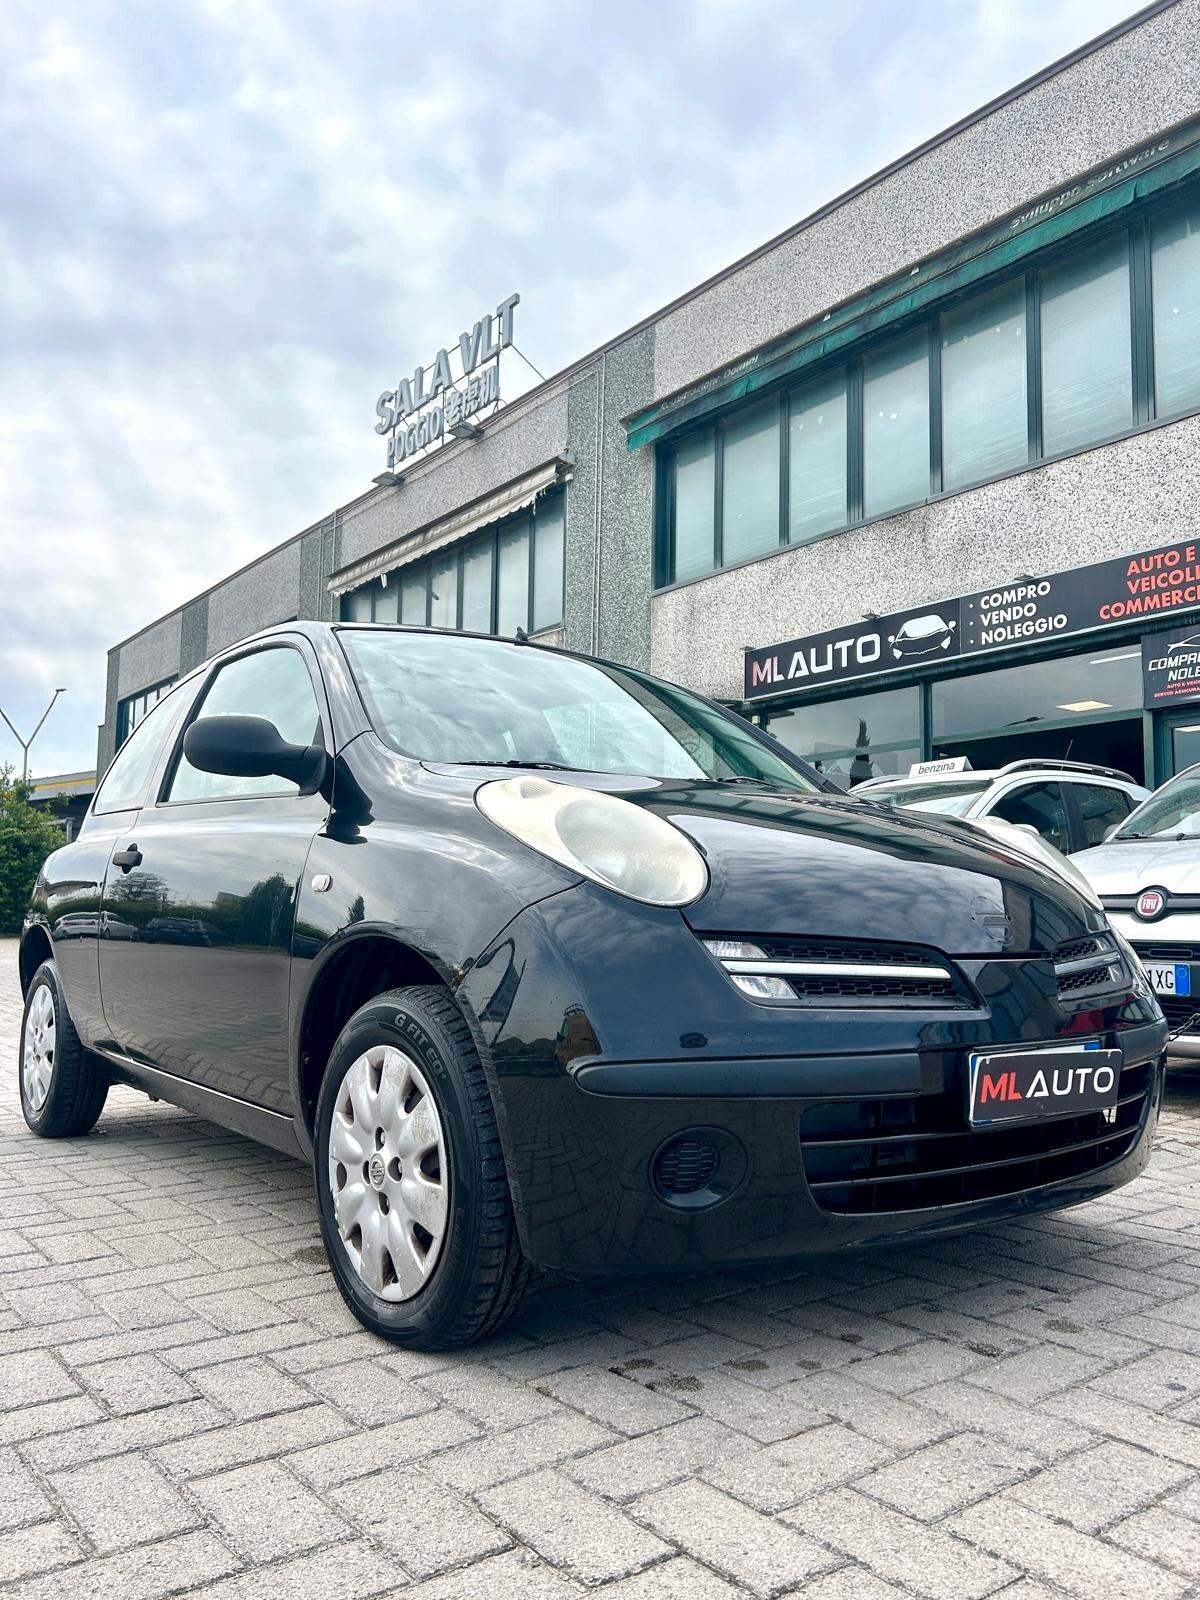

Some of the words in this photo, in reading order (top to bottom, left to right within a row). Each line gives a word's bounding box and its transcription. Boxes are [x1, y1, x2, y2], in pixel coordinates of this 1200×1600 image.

[375, 348, 453, 435] SALA
[459, 293, 520, 375] VLT
[387, 406, 445, 467] POGGIO
[1127, 550, 1180, 577] AUTO
[1185, 546, 1196, 562] E
[980, 581, 1051, 610] COMPRO
[980, 602, 1037, 627] VENDO
[981, 613, 1068, 646] NOLEGGIO
[1167, 682, 1181, 690] AUTO
[918, 762, 956, 775] benzina
[1142, 898, 1158, 910] FIAT
[406, 1022, 429, 1046] FIT
[1025, 1066, 1115, 1099] AUTO
